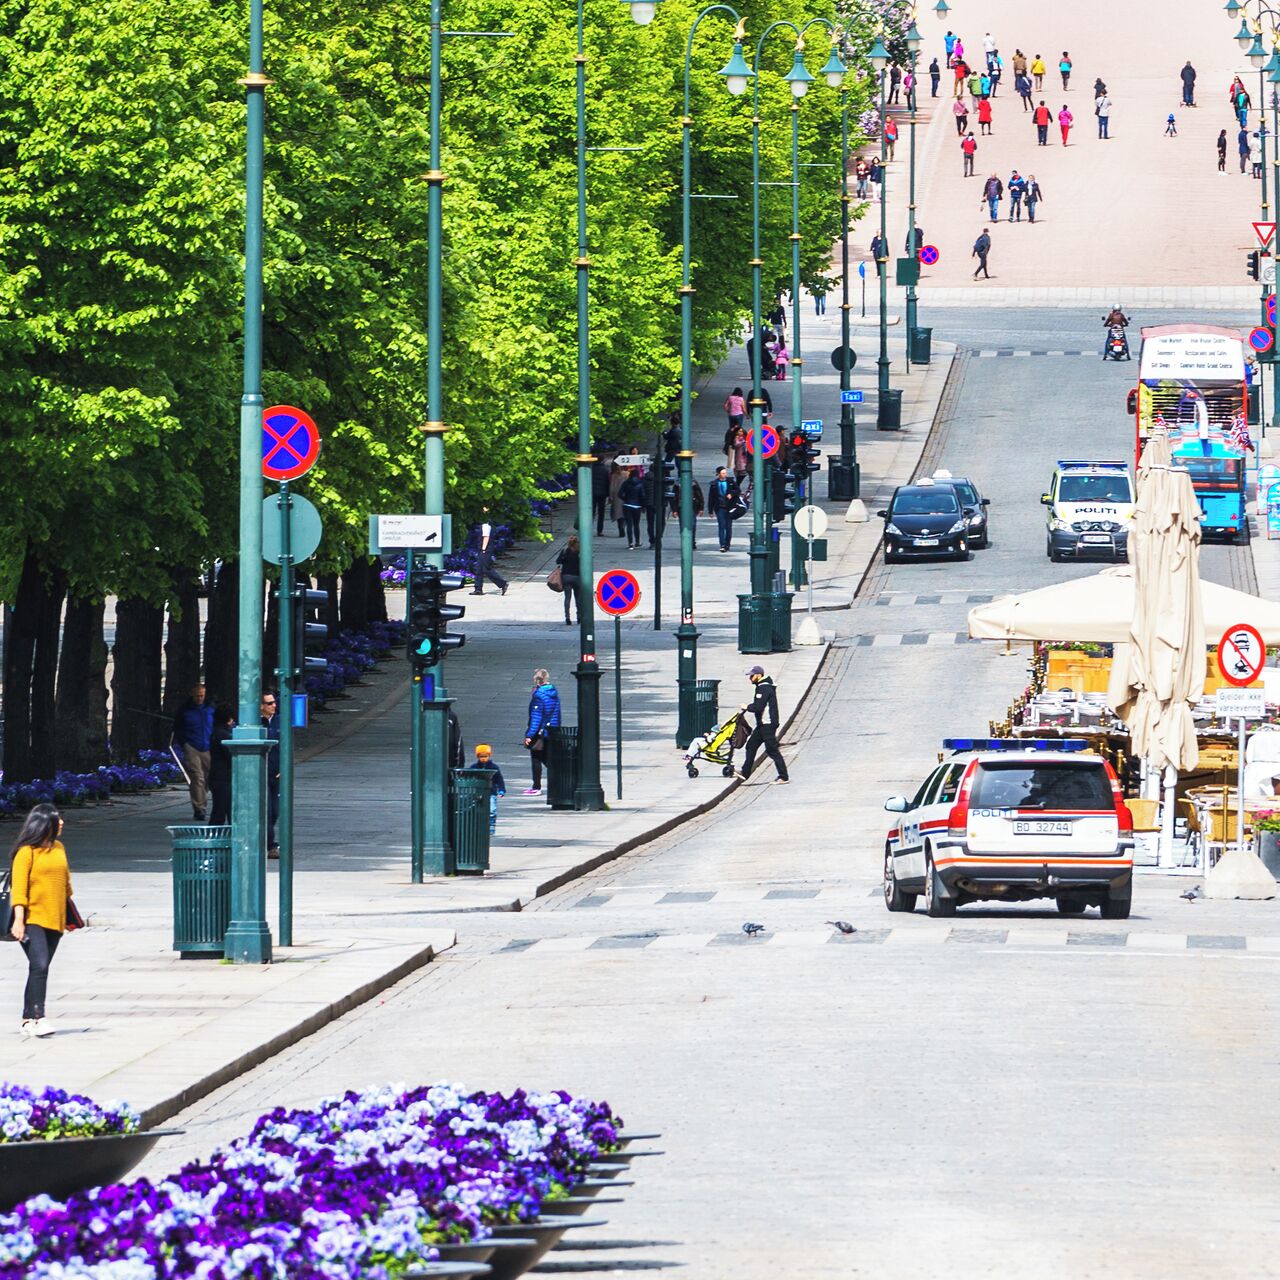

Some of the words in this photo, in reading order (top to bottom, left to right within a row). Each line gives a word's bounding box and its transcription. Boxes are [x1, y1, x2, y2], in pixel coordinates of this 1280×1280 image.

[801, 422, 820, 430] Taxi
[1075, 507, 1117, 515] POLITI
[972, 809, 1012, 818] POLITI
[1036, 822, 1069, 832] 32744
